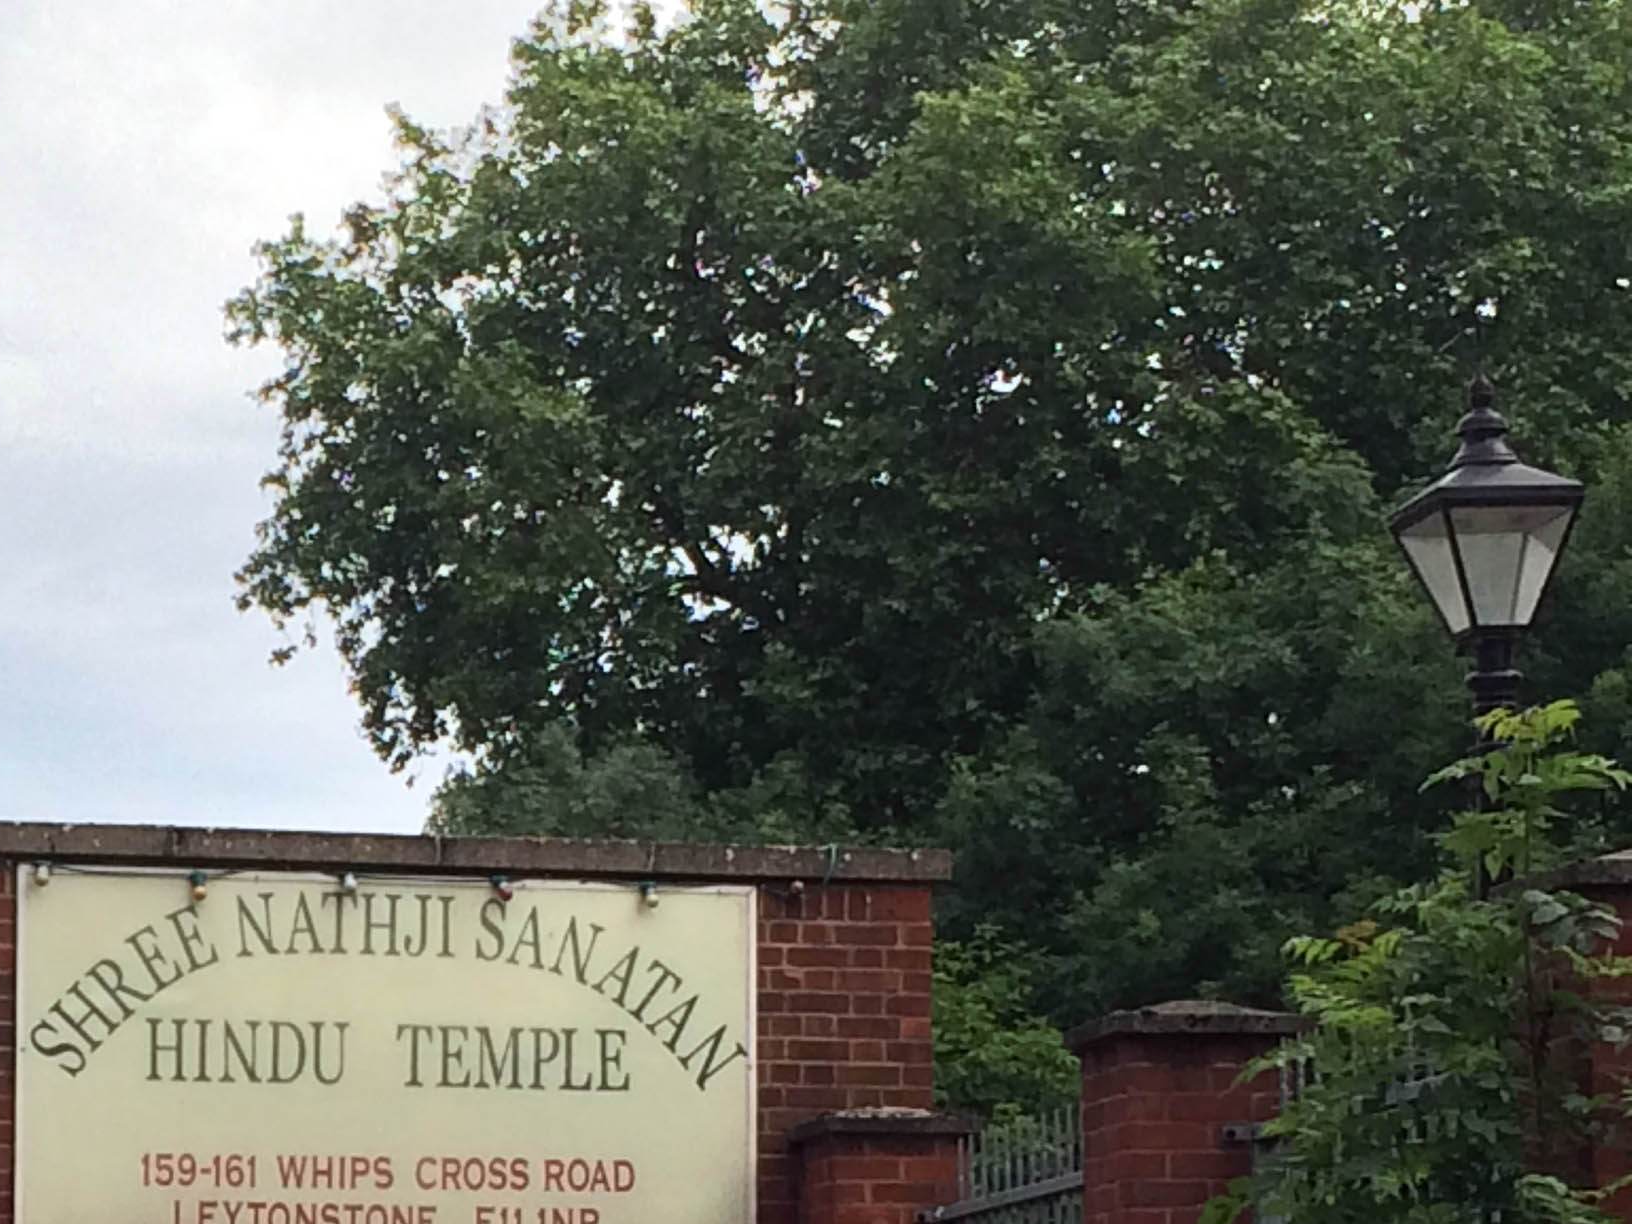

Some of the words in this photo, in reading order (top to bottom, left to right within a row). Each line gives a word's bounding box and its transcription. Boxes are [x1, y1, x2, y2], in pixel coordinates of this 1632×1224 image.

[29, 903, 220, 1078] SHREE
[236, 890, 455, 958] NATHJI
[476, 897, 750, 1092] SANATAN
[145, 1017, 350, 1086] HINDU
[395, 1024, 631, 1092] TEMPLE
[142, 1153, 257, 1189] 159-161
[276, 1154, 395, 1190] WHIPS
[415, 1156, 530, 1192] CROSS
[543, 1158, 636, 1193] ROAD
